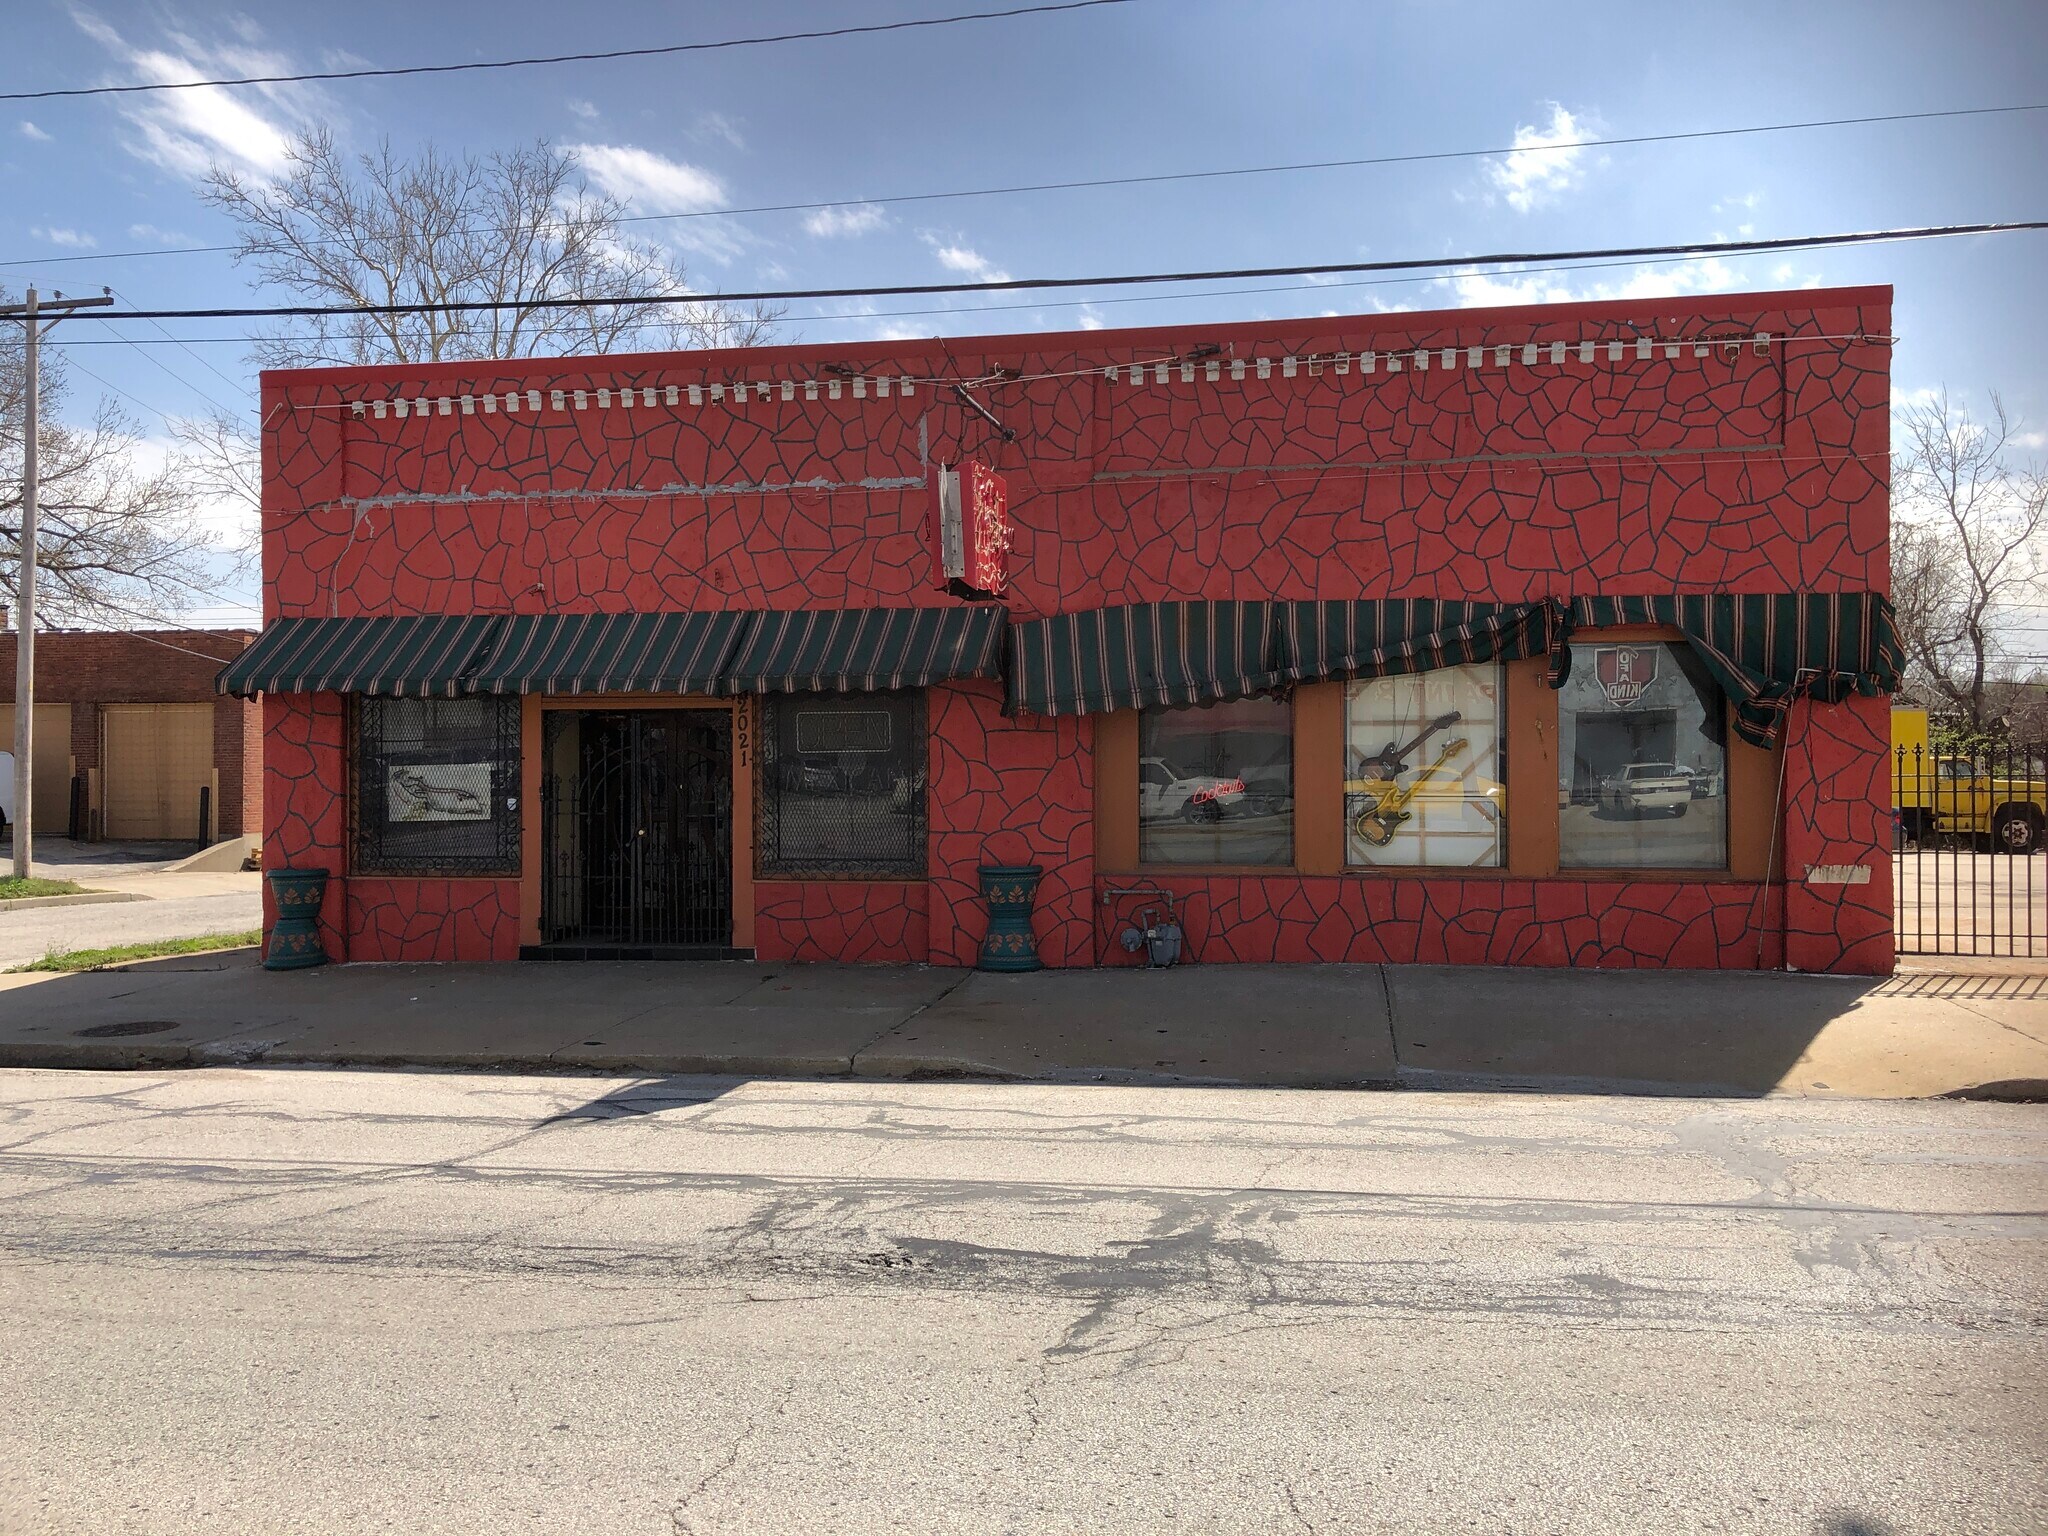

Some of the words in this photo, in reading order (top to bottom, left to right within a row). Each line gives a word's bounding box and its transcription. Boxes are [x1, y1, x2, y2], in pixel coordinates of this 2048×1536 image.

[737, 697, 749, 767] 2021
[800, 715, 887, 749] OPEN
[1193, 776, 1245, 805] Cocktails
